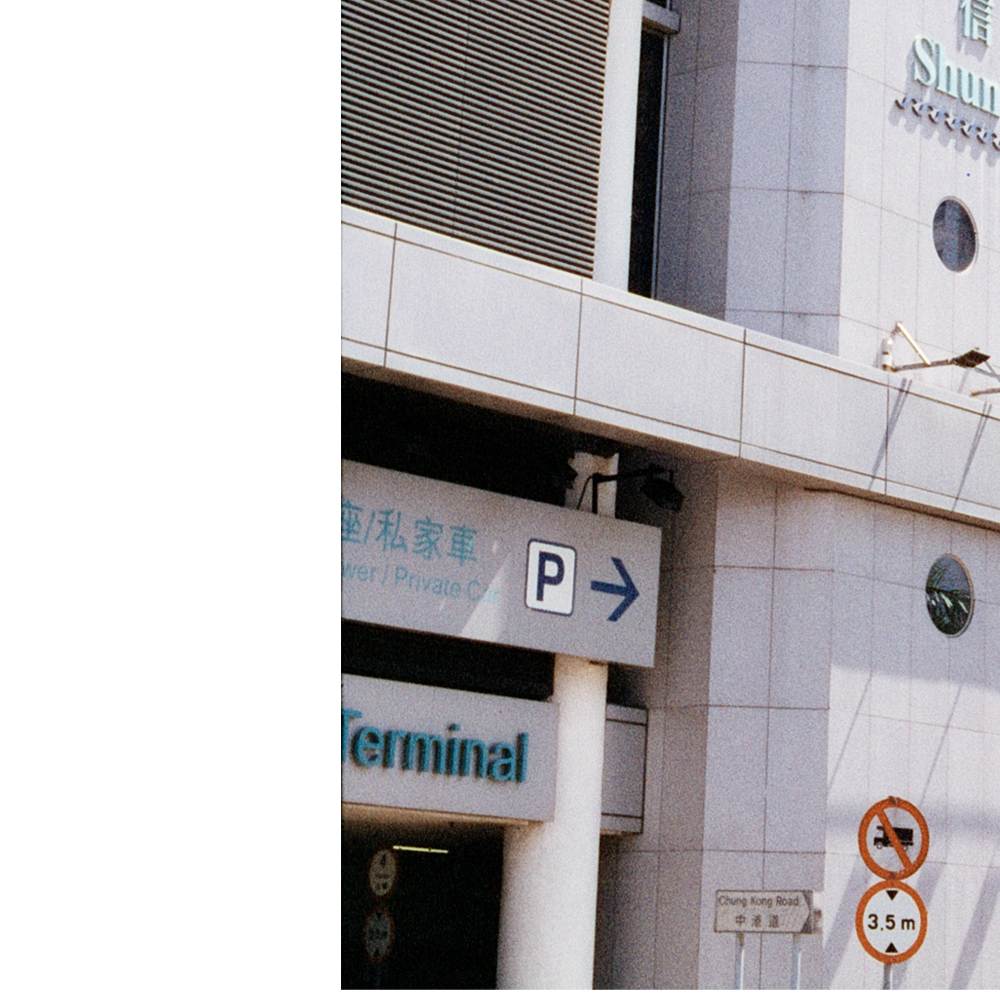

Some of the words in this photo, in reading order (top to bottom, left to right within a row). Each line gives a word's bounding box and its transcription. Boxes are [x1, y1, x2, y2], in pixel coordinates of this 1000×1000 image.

[913, 34, 1000, 118] Shun
[394, 566, 460, 600] Private
[535, 551, 566, 602] P
[341, 709, 529, 784] Terminal
[719, 895, 748, 908] Chung
[750, 896, 773, 909] Kong
[775, 895, 799, 907] Road
[735, 914, 780, 929] 中港道
[867, 913, 896, 931] 3.5
[900, 917, 916, 931] m
